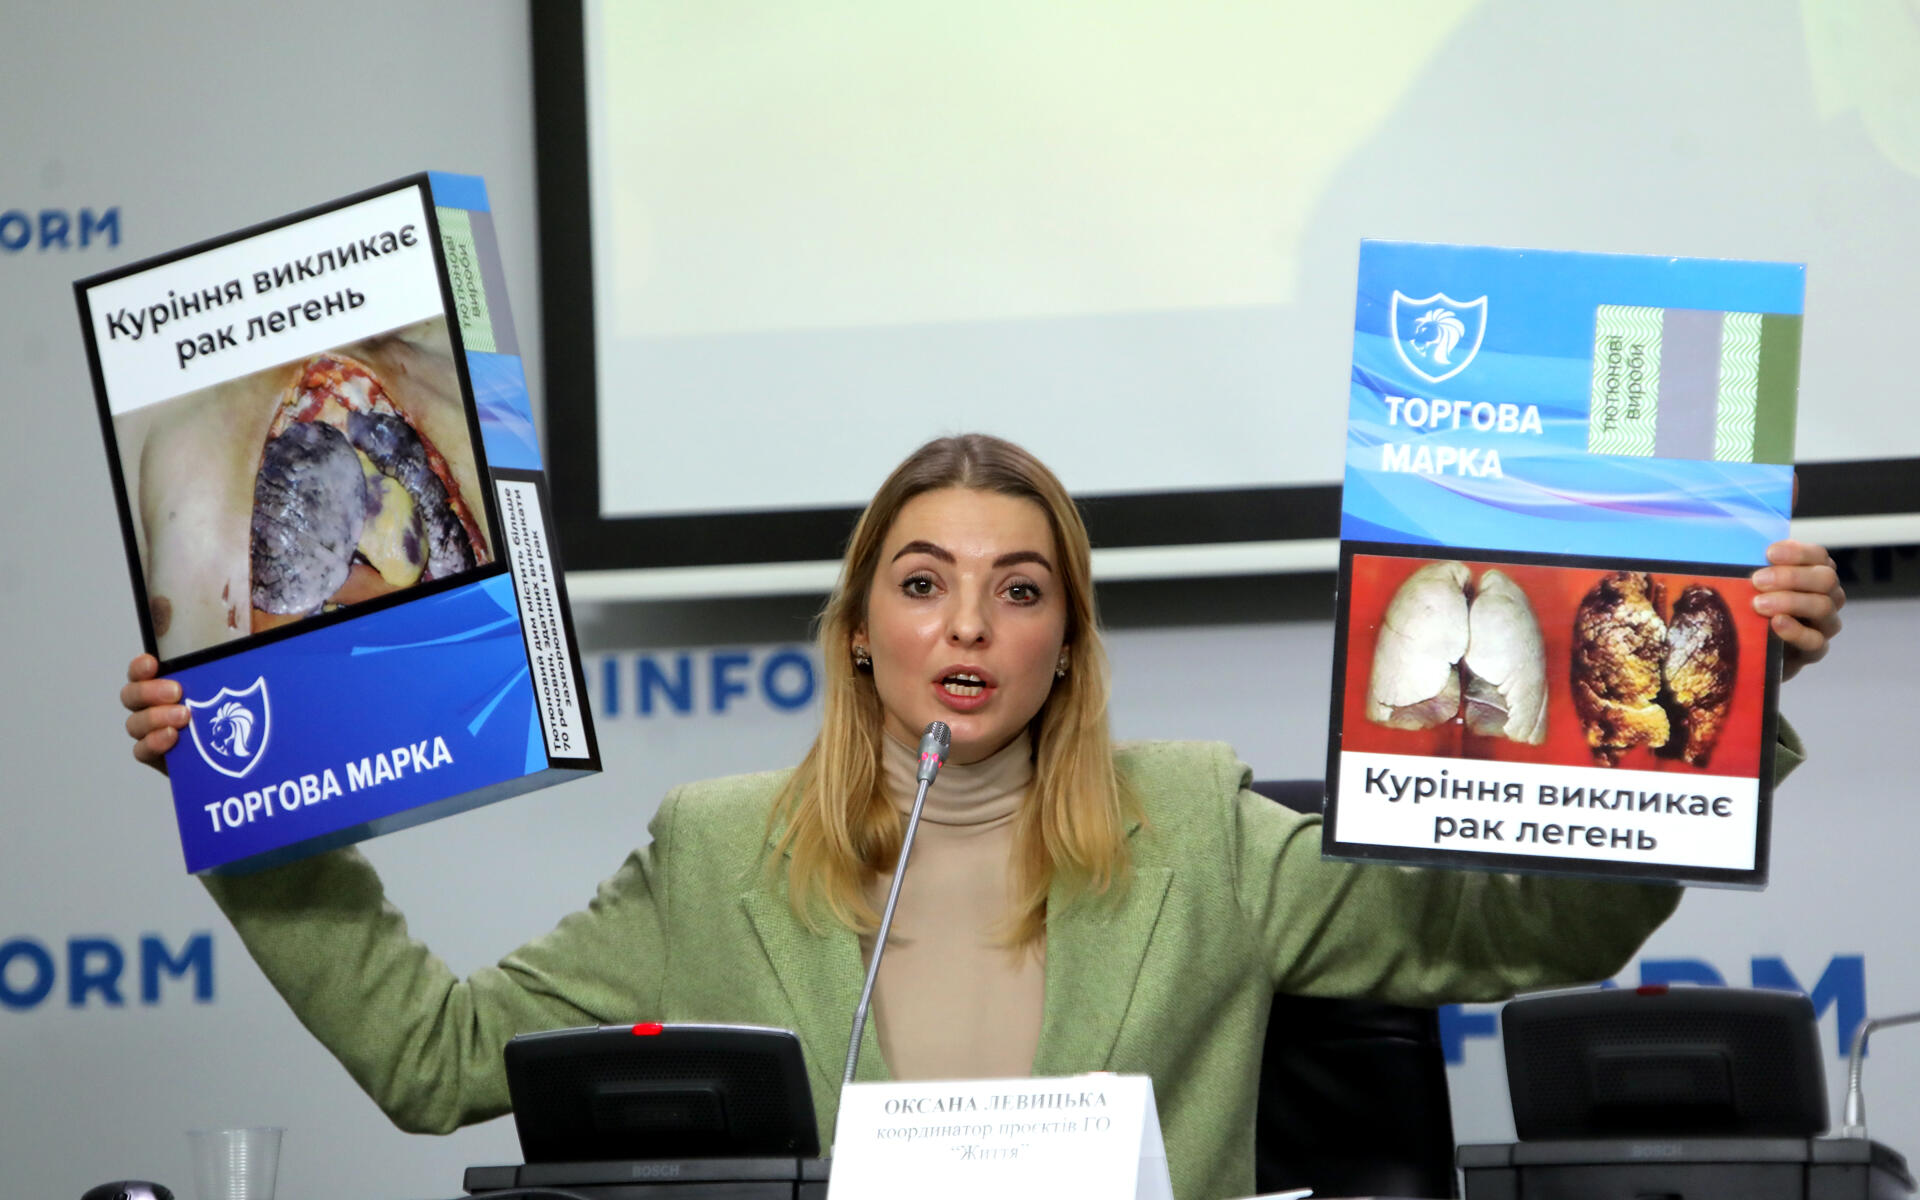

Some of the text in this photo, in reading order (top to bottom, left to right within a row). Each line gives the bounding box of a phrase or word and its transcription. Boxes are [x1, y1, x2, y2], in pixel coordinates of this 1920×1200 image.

[0, 206, 122, 254] ORM
[106, 225, 418, 342] Куріння викликає
[175, 288, 366, 369] рак легень
[1384, 395, 1543, 435] ТОРГОВА
[1603, 335, 1623, 433] тютюнові
[1626, 343, 1646, 420] вироби
[1381, 443, 1501, 479] МАРКА
[505, 488, 561, 752] Тютюновий дим містить більше
[514, 489, 571, 751] 70 речовин, здатних викликати
[532, 531, 572, 707] захворювання на рак
[583, 650, 817, 716] INFO
[204, 736, 453, 833] ТОРГОВА МАРКА
[1364, 767, 1733, 818] Куріння викликає
[1433, 813, 1658, 851] рак легень
[0, 932, 215, 1012] ORM
[876, 1122, 992, 1142] координатор
[1081, 1117, 1111, 1133] ГО
[884, 1092, 1107, 1115] ОКСАНА ЛЕВИЦЬКА
